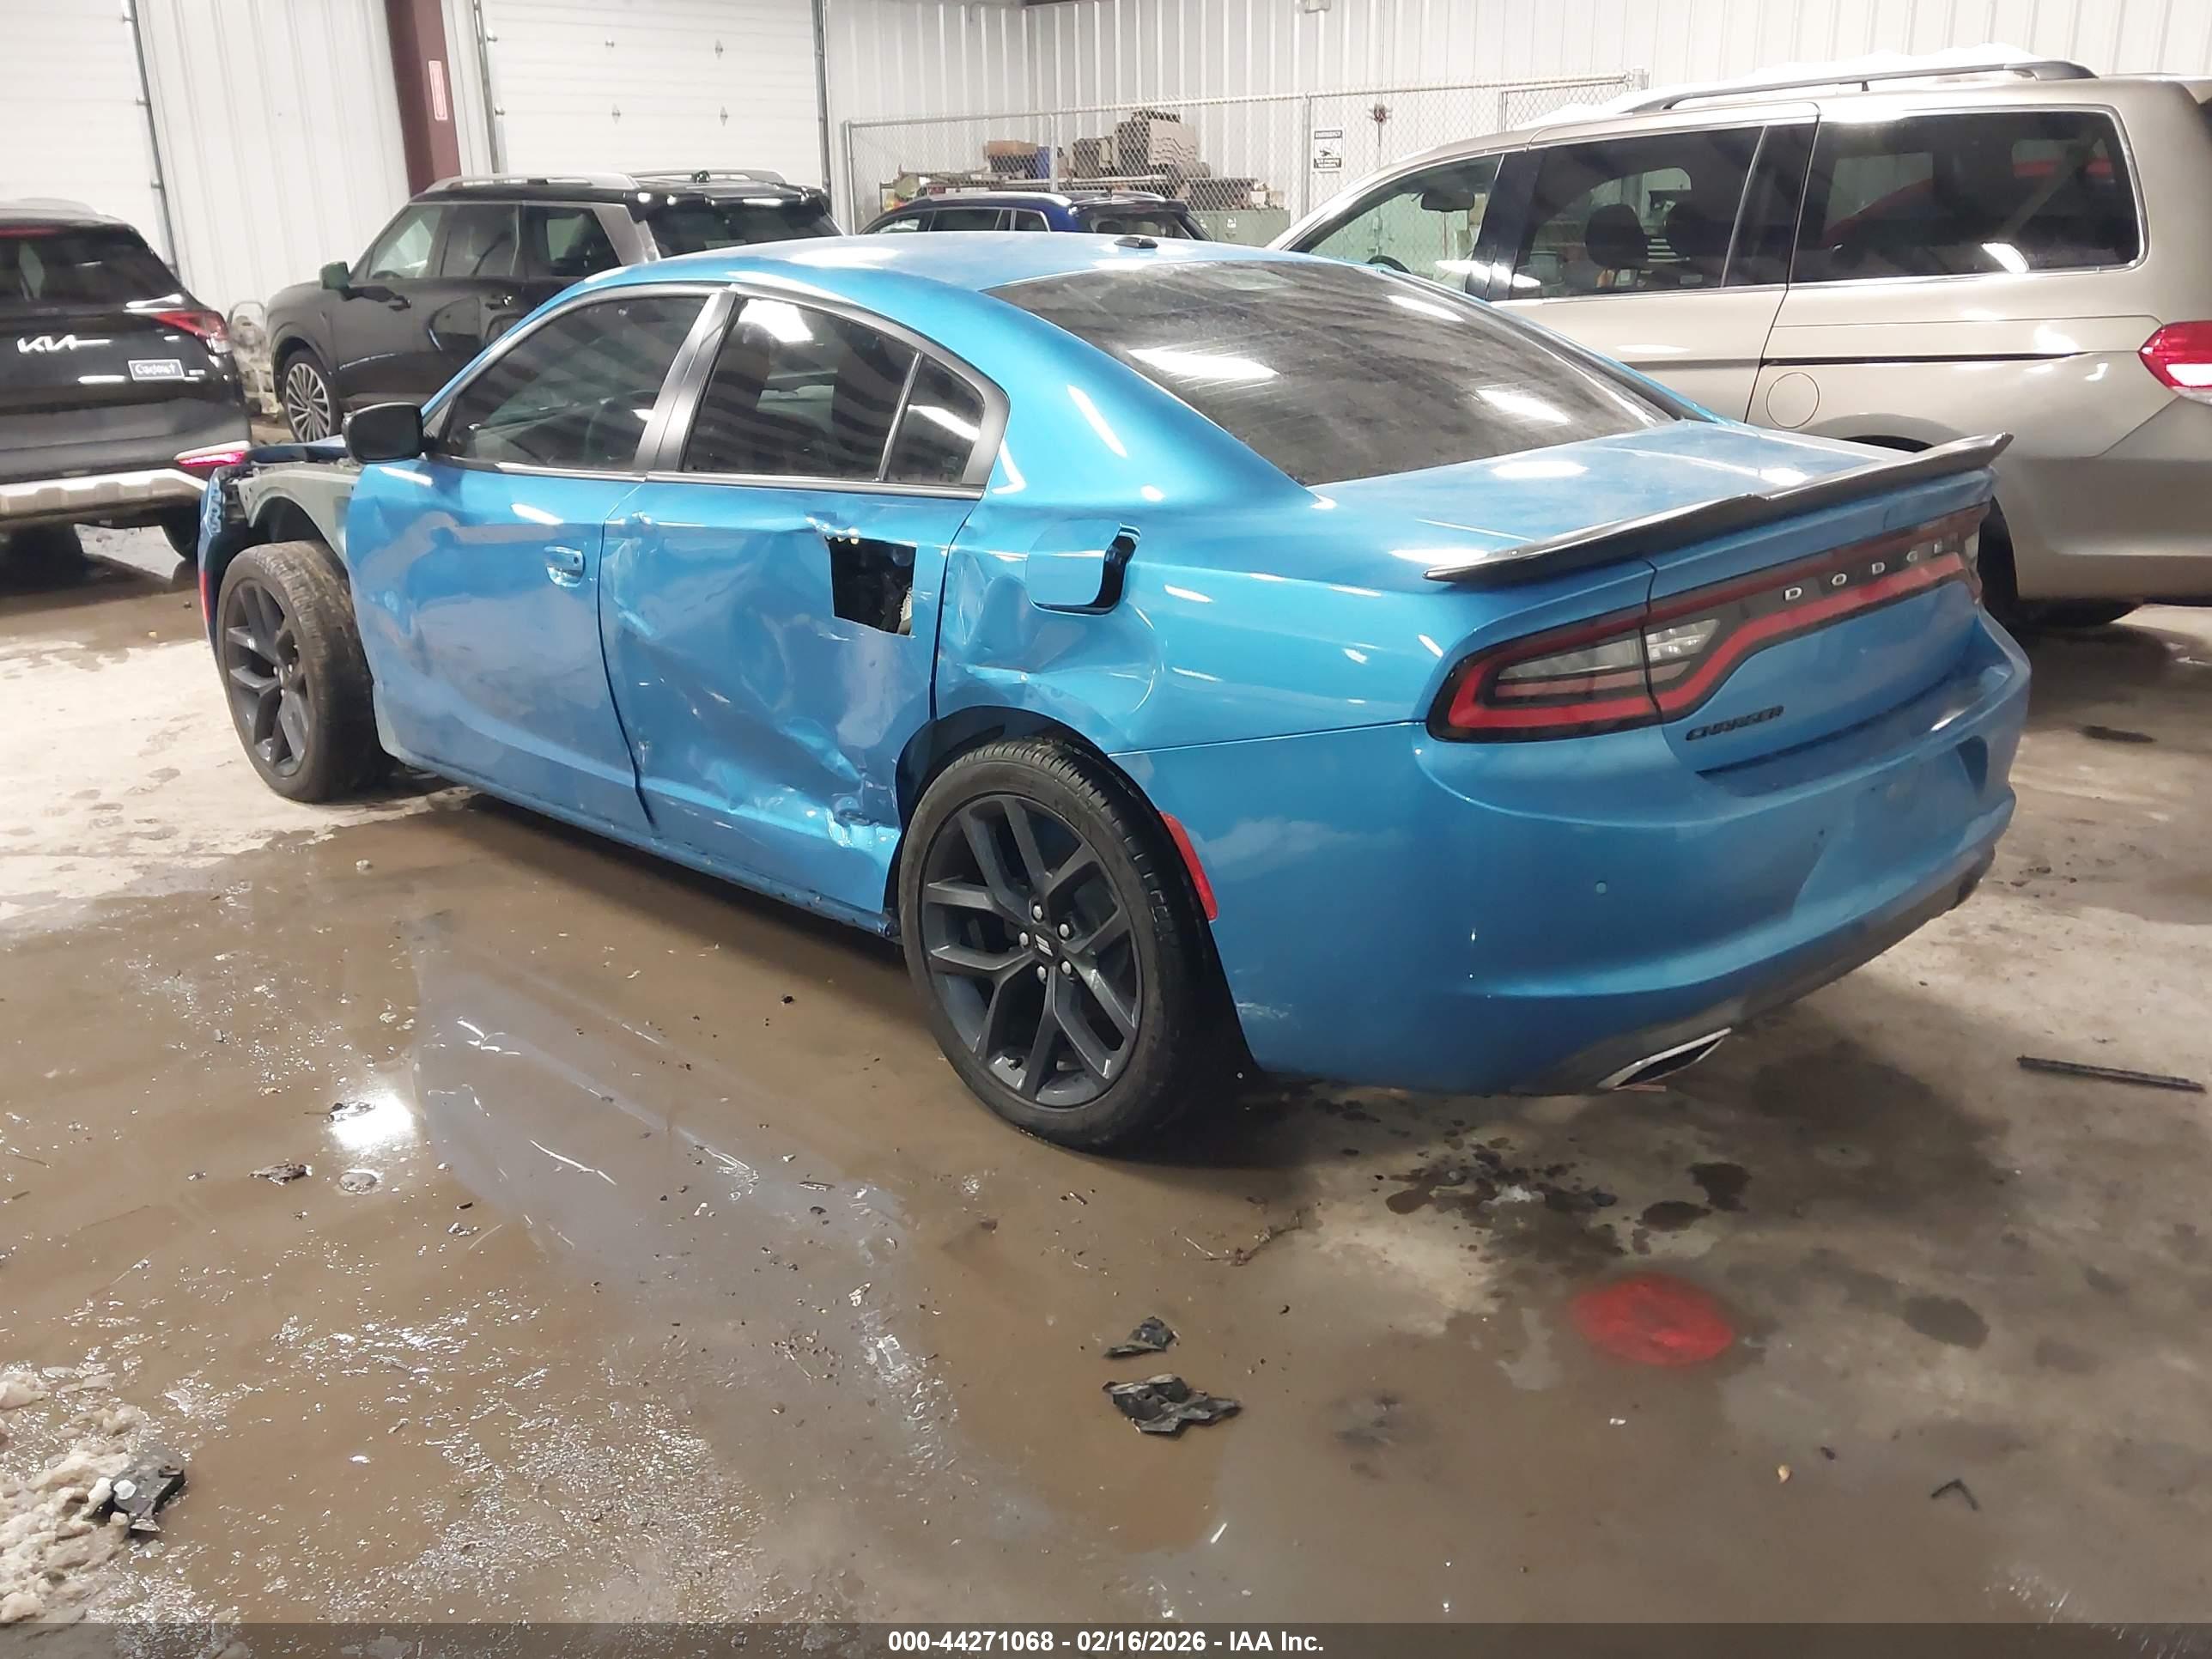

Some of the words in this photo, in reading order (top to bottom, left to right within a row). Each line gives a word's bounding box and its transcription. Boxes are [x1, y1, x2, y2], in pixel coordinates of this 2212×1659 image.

[17, 335, 77, 353] KIA
[1784, 540, 1945, 602] DODGE
[1686, 705, 1784, 741] CHARGER
